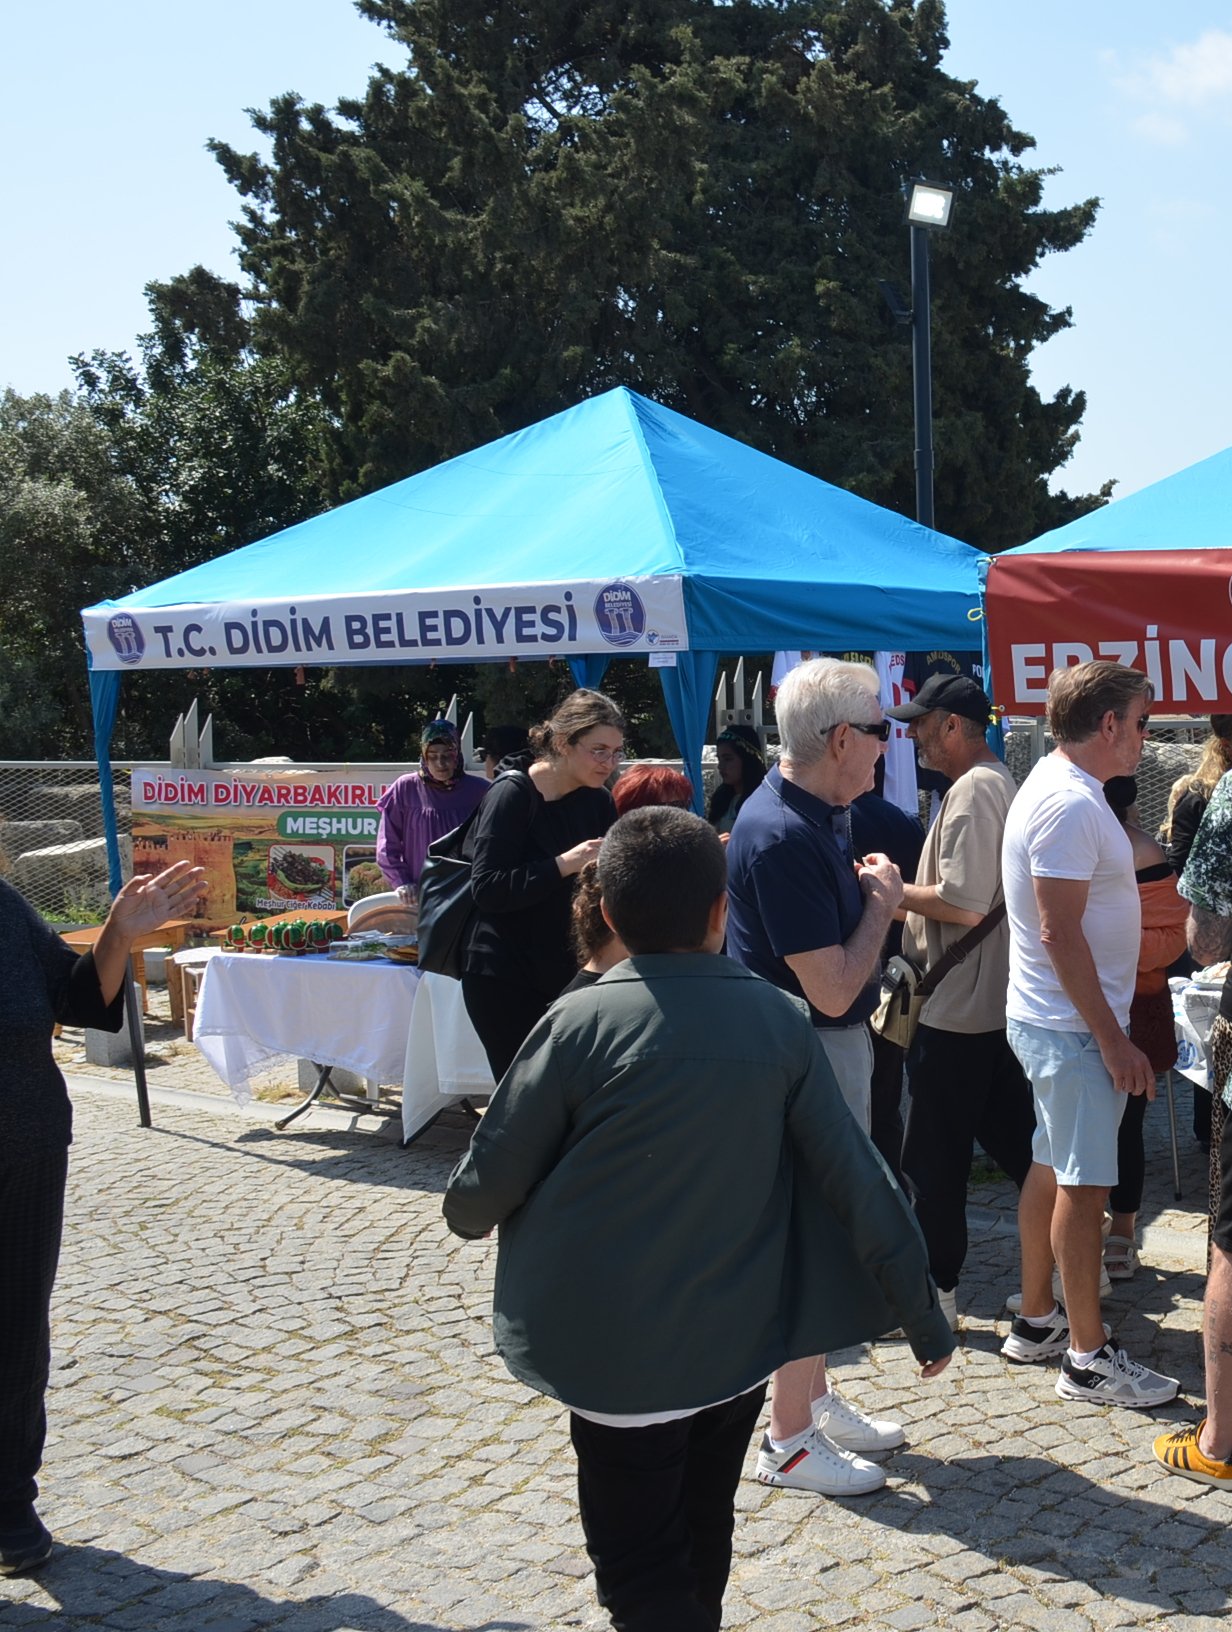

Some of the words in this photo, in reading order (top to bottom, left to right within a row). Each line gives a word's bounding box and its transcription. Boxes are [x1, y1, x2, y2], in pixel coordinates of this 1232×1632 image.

[603, 589, 631, 602] DİDİM
[153, 623, 217, 658] T.C.
[223, 606, 334, 655] DİDİM
[344, 591, 577, 651] BELEDİYESİ
[142, 775, 206, 804] DİDİM
[286, 817, 377, 838] MEŞHUR
[257, 898, 285, 909] Meşhur
